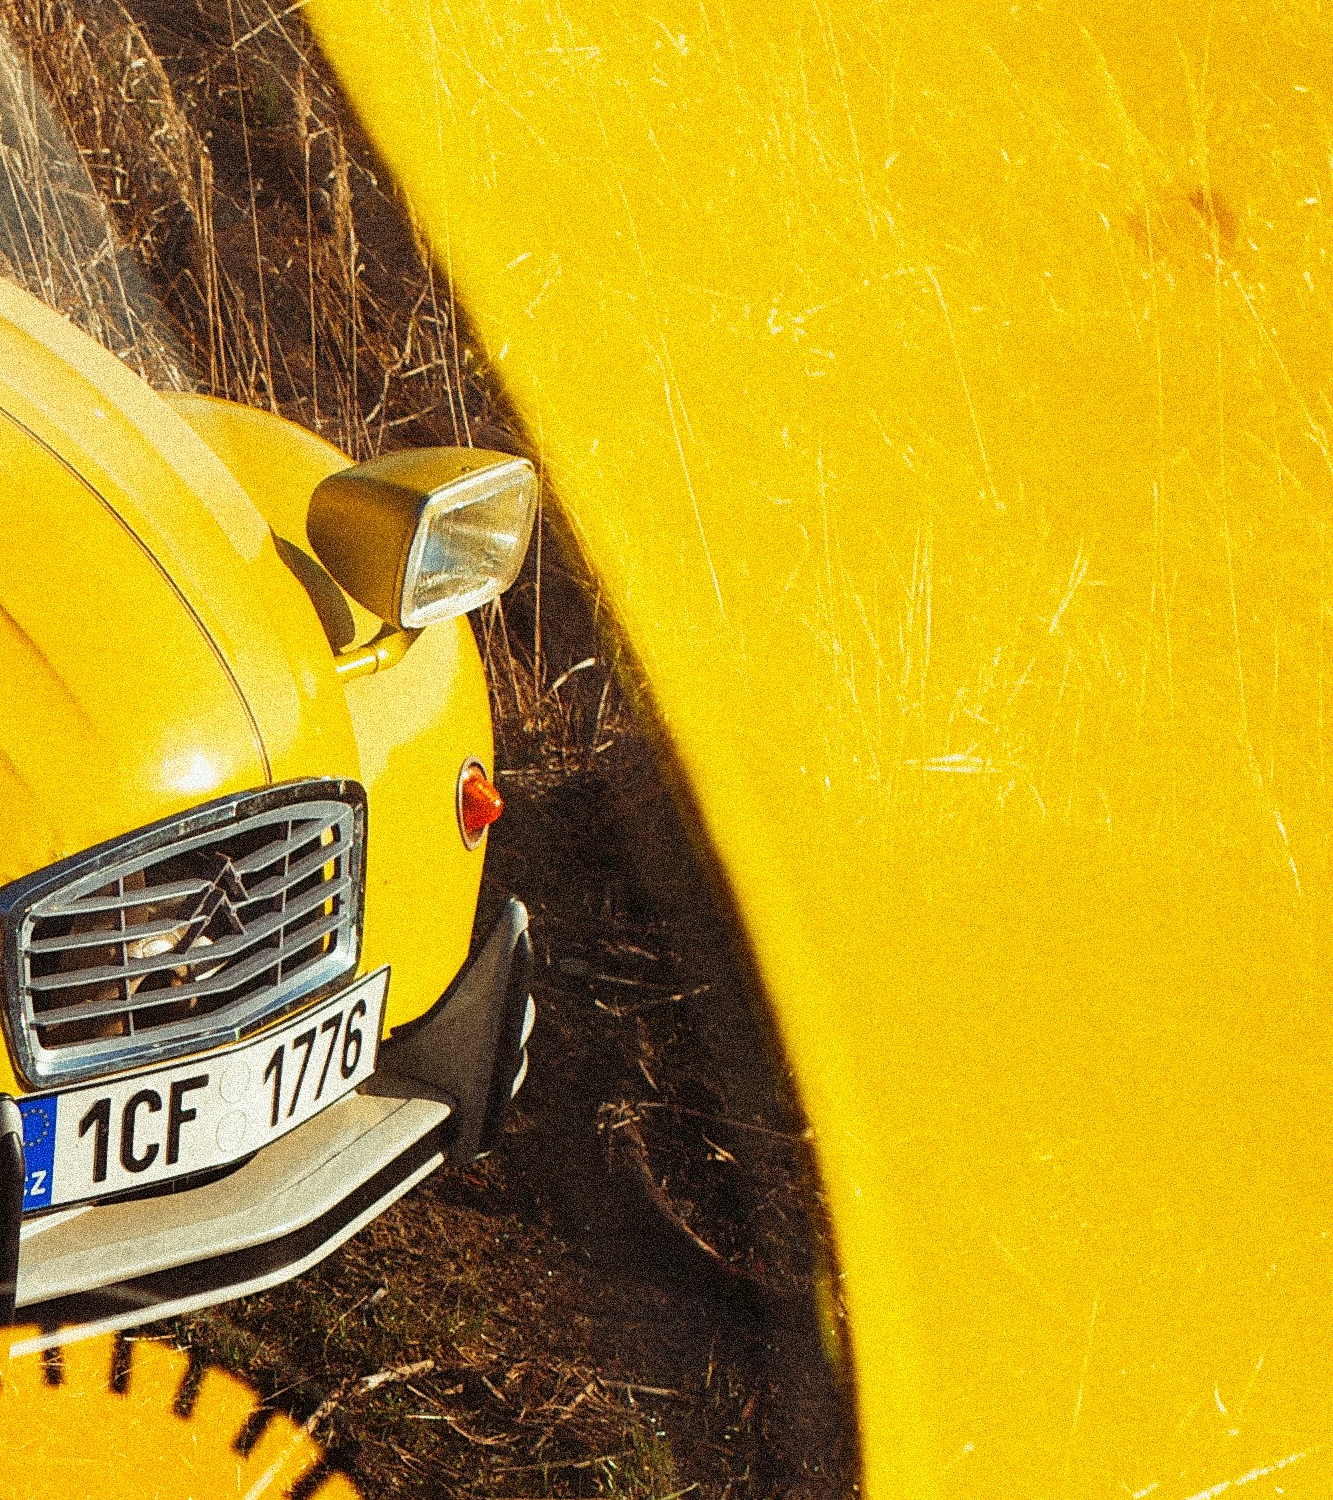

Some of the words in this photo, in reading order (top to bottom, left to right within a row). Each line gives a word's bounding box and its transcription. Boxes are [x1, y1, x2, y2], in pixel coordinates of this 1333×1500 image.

[78, 1074, 209, 1183] 1CF
[264, 999, 366, 1127] 1776
[23, 1169, 47, 1196] Z
